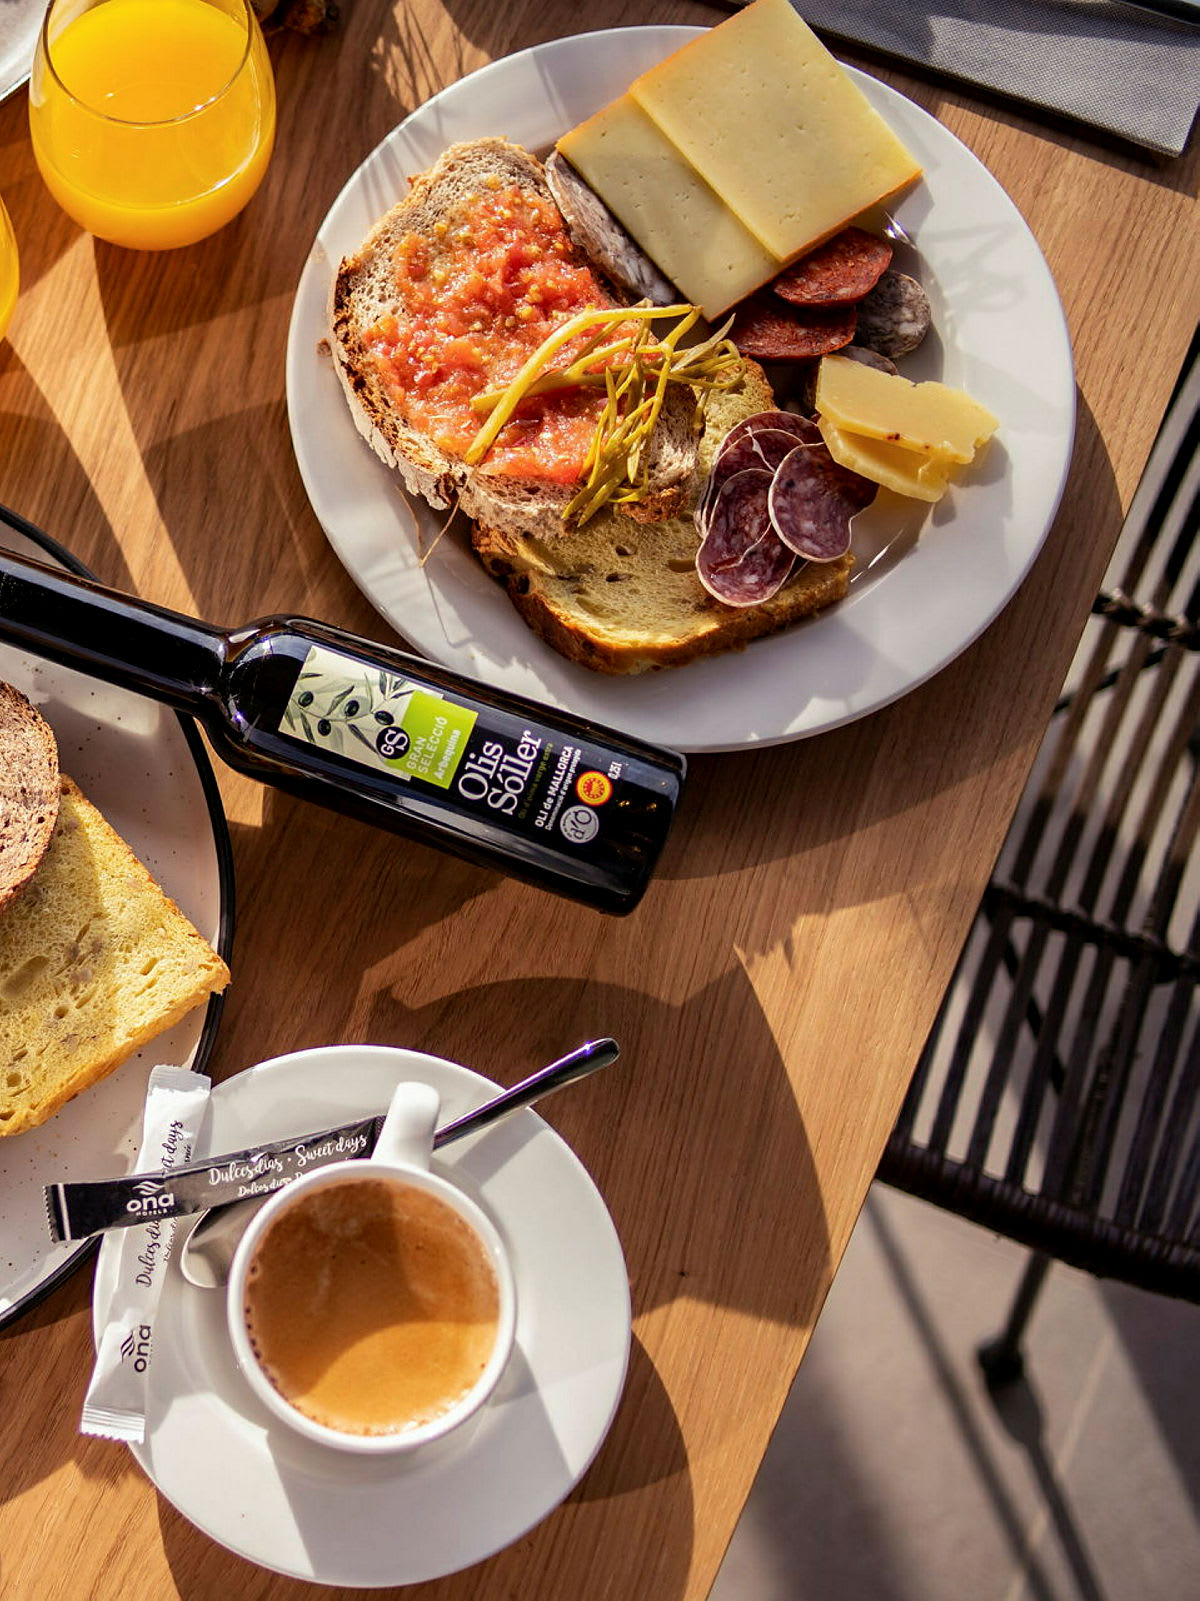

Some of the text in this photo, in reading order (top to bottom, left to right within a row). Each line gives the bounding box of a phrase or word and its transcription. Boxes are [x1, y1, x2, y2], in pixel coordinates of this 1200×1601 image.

[406, 736, 427, 770] GRAN
[417, 716, 448, 774] SELECCIÓ
[458, 741, 504, 801] Olis
[487, 729, 542, 816] Sóller
[547, 745, 575, 797] MALLORCA
[534, 809, 549, 828] OLI
[543, 797, 554, 810] de
[161, 1119, 184, 1152] days
[208, 1161, 253, 1186] Dulces
[294, 1144, 335, 1167] Sweet
[335, 1133, 368, 1153] days
[126, 1192, 175, 1214] ona
[135, 1241, 161, 1288] Dulces
[133, 1324, 152, 1373] ona
